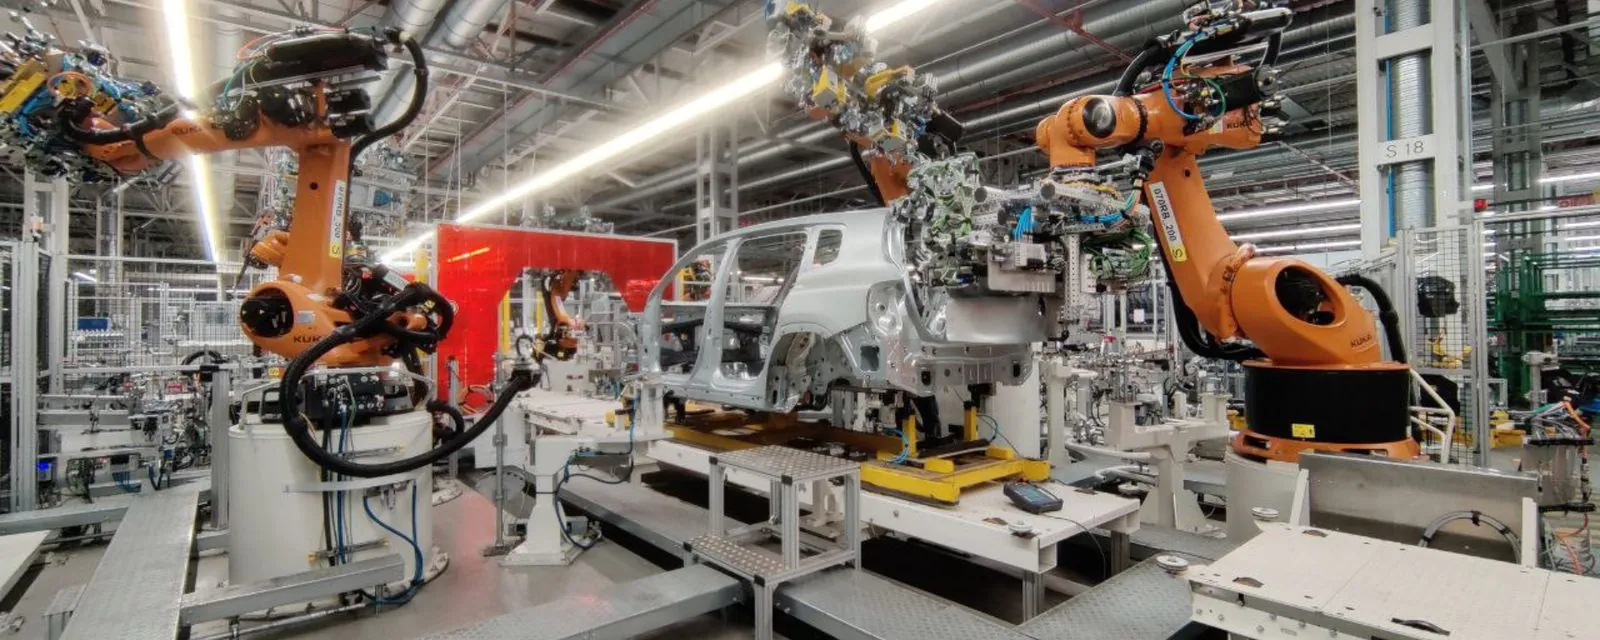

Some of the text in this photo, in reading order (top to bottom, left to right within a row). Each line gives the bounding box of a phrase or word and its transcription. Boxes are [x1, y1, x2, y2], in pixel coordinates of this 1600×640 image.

[1386, 140, 1424, 158] S 18
[293, 335, 321, 344] KUK
